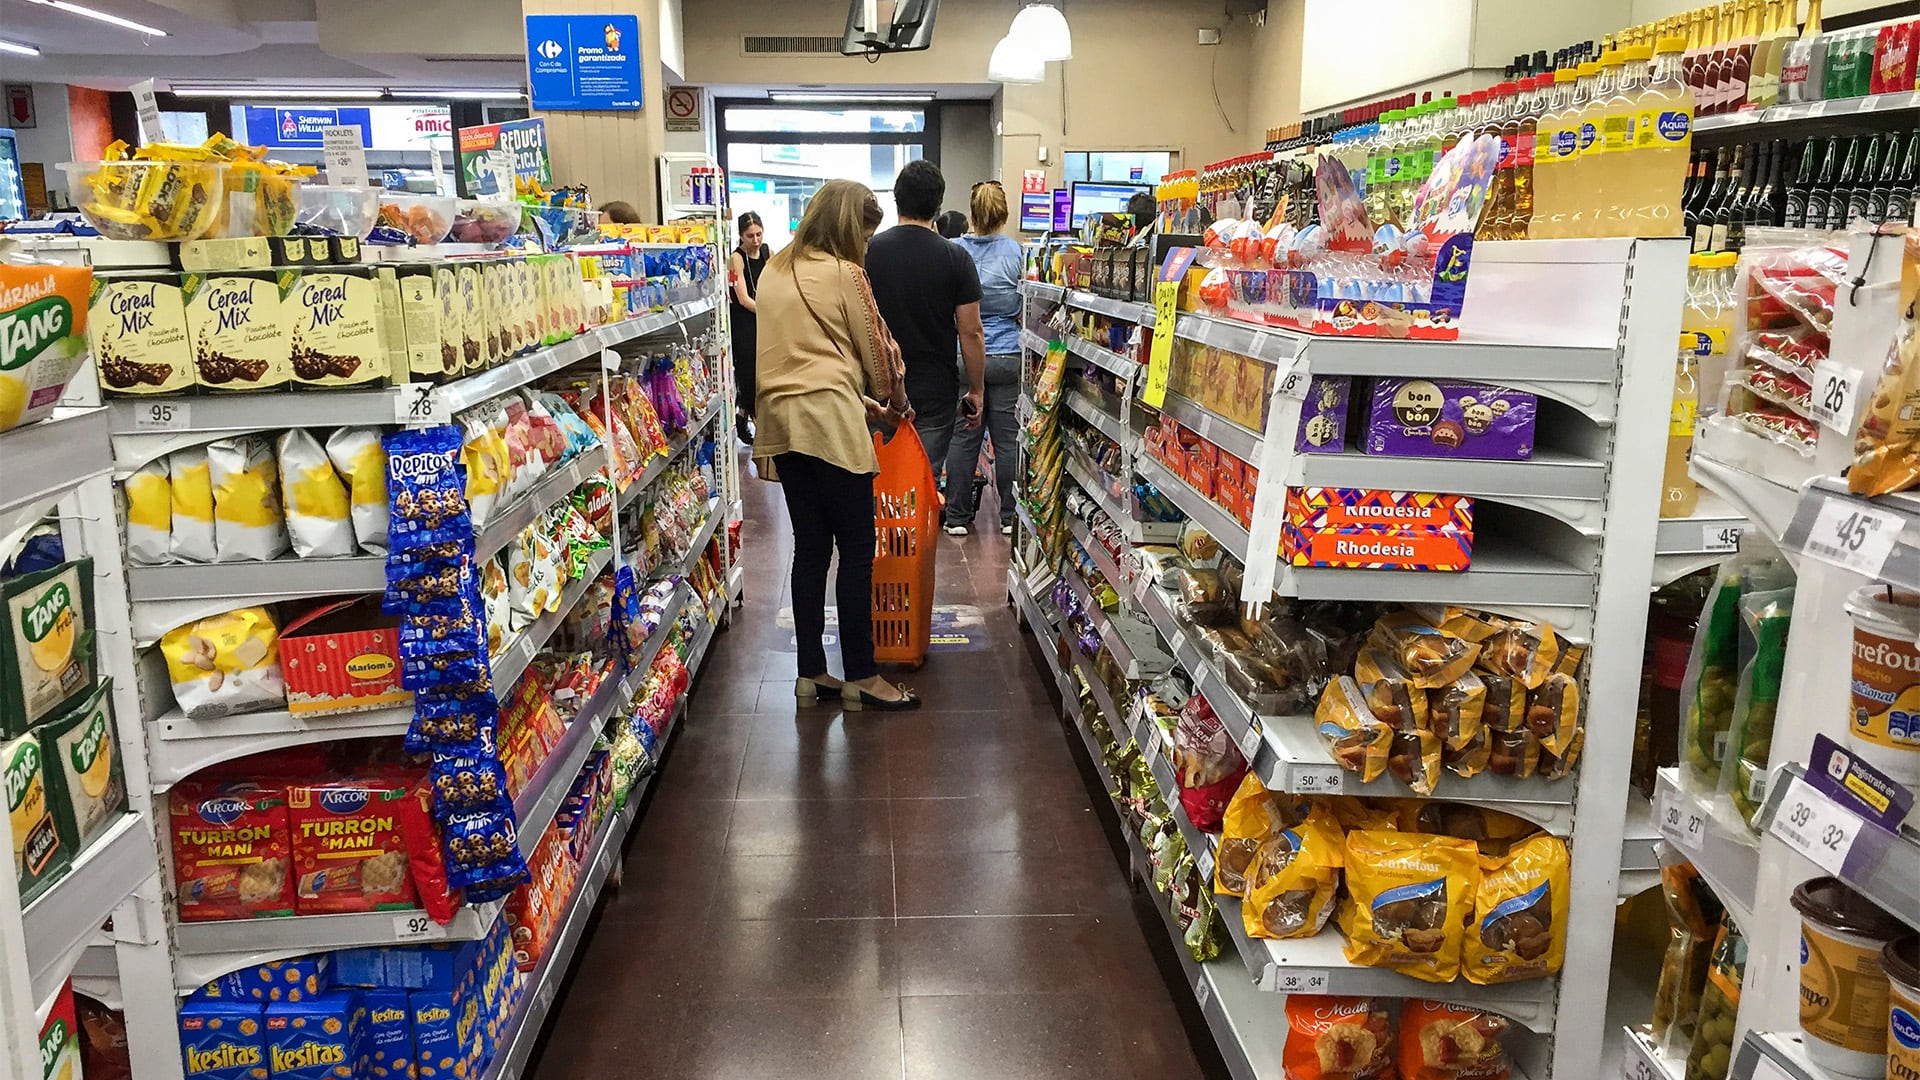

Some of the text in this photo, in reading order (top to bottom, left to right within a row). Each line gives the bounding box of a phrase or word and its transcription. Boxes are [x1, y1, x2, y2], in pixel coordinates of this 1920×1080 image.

[578, 46, 603, 54] Promo
[578, 54, 626, 63] garantizada
[298, 115, 332, 125] SHERWIN
[500, 124, 542, 151] REDUCÍ
[110, 284, 156, 315] Cereal
[208, 280, 255, 311] Cereal
[302, 276, 349, 307] Cereal
[118, 311, 153, 339] Mix
[214, 306, 251, 335] Mix
[309, 304, 344, 332] Mix
[0, 304, 63, 366] TANG
[180, 368, 185, 376] 6
[276, 364, 282, 372] 6
[368, 360, 374, 368] 6
[1408, 392, 1431, 402] bon
[1406, 411, 1430, 421] bon
[1468, 420, 1482, 428] bon
[1336, 541, 1415, 557] Rhodesia
[27, 586, 65, 640] TANG
[77, 715, 102, 770] TANG
[4, 746, 37, 802] TANG
[322, 791, 368, 804] ARCOR
[1885, 788, 1896, 798] en
[201, 801, 246, 813] ARCOR
[179, 824, 271, 845] TURRÓN
[300, 815, 393, 838] TURRÓN
[208, 842, 252, 856] MANÍ
[329, 832, 375, 849] MANÍ
[372, 1008, 405, 1024] kesitas
[416, 1007, 450, 1024] kesitas
[188, 1044, 260, 1073] kesitas
[271, 1042, 343, 1072] kesitas
